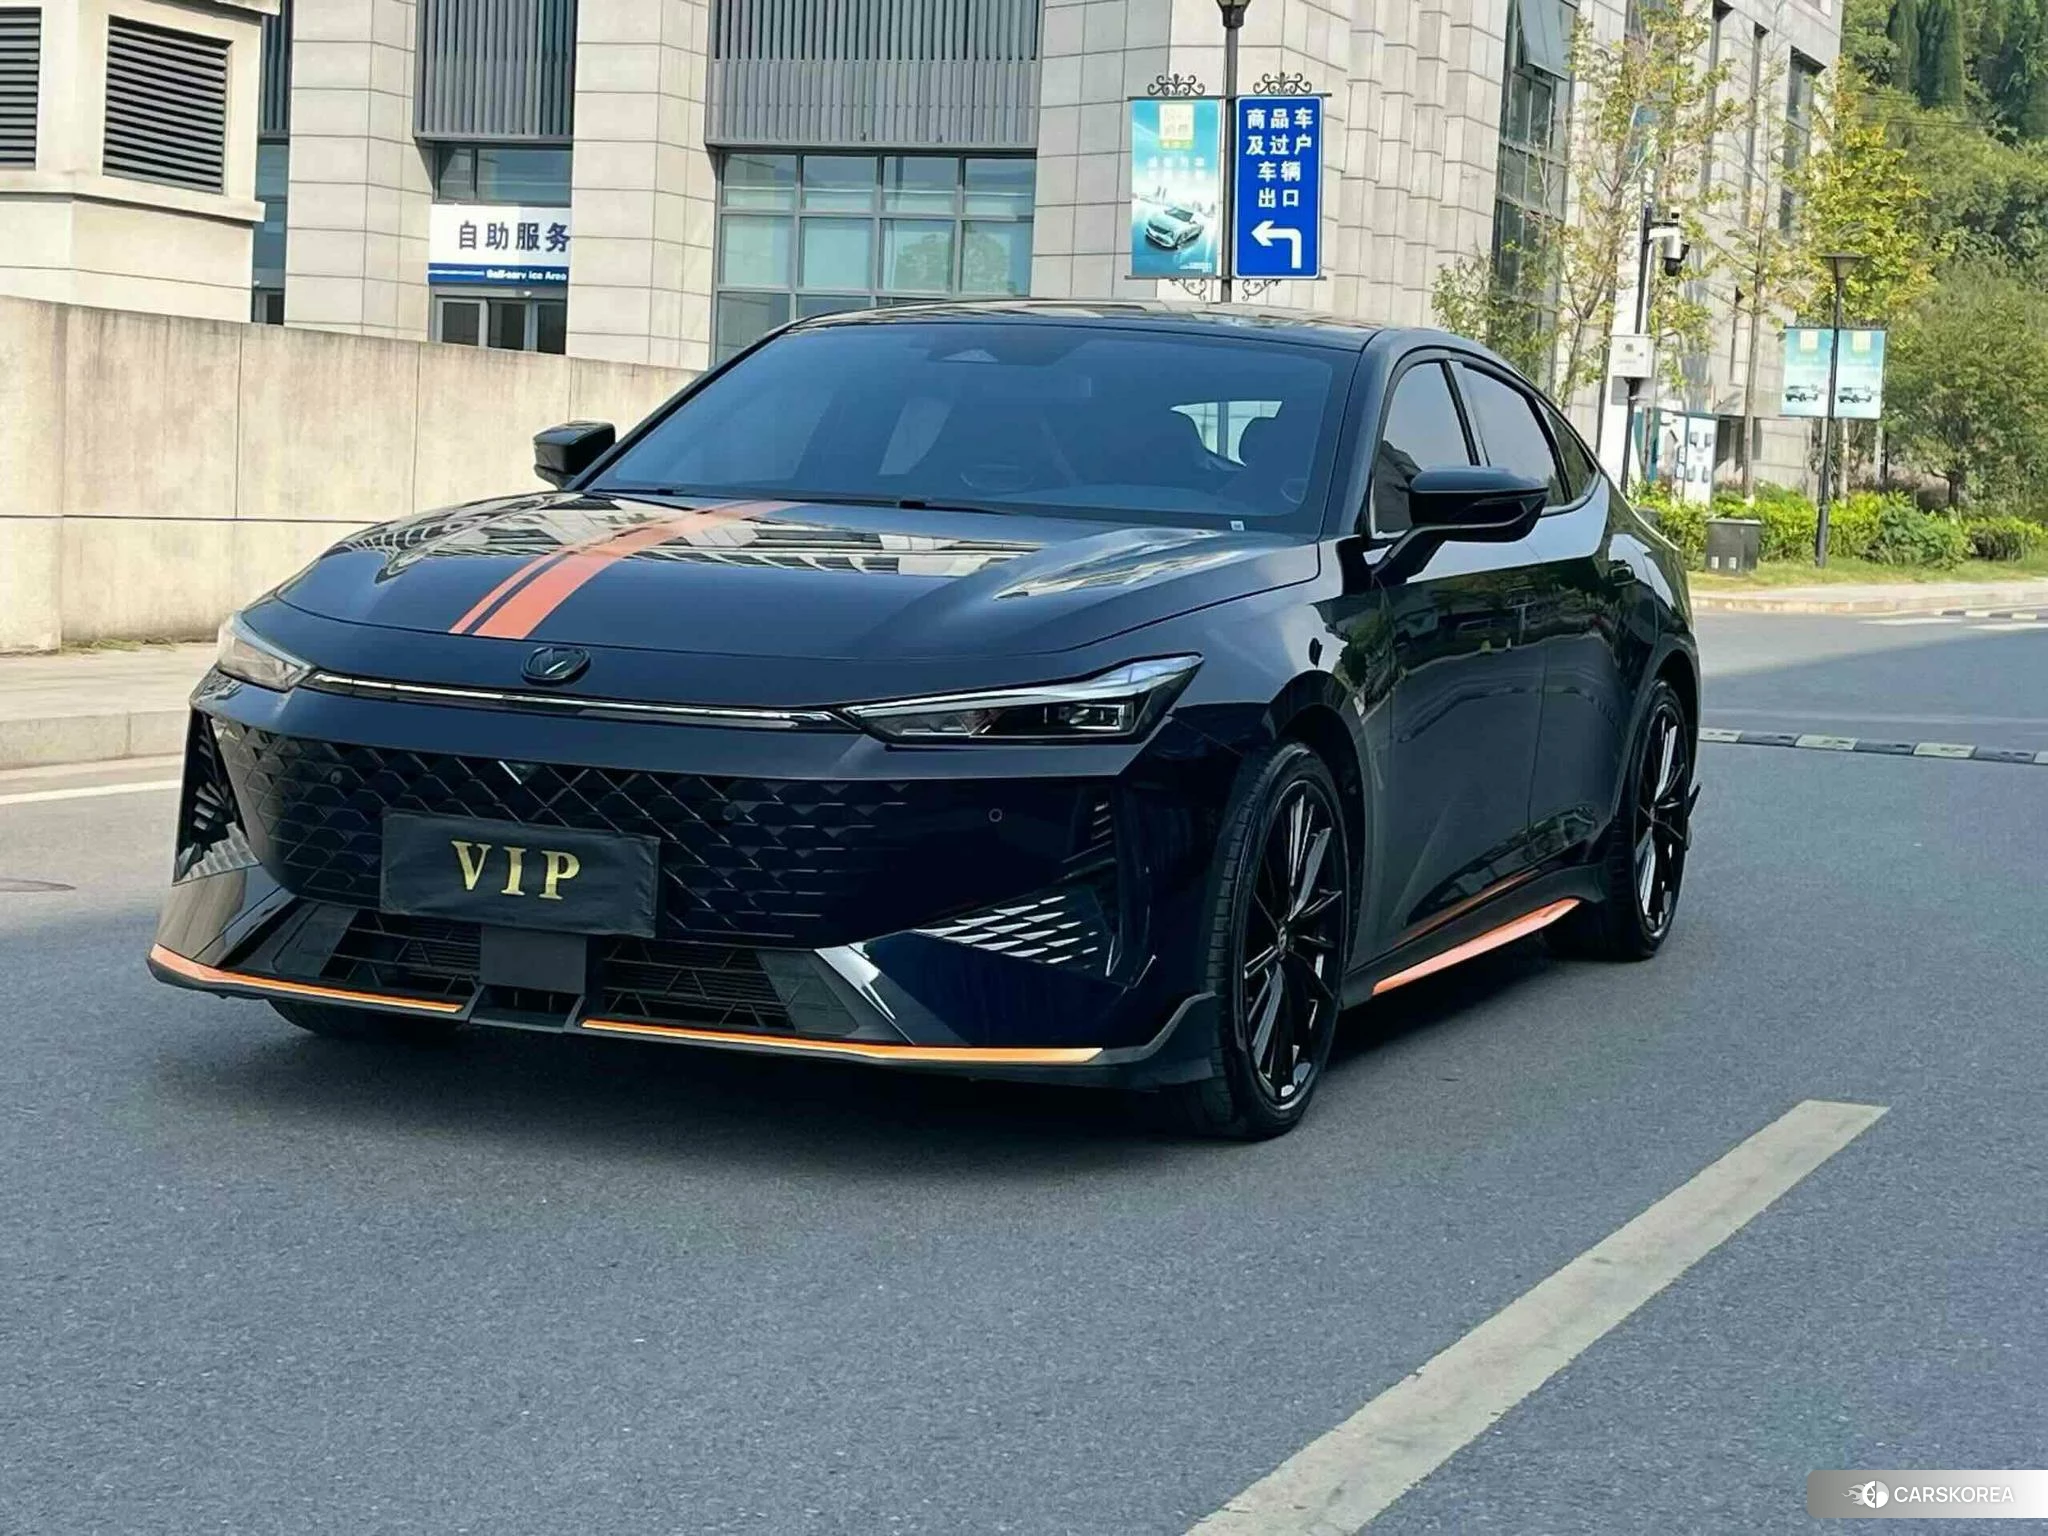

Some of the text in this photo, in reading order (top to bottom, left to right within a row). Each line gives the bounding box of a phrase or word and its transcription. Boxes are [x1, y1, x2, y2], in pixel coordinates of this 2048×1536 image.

[1246, 107, 1313, 130] 商品车
[1246, 134, 1312, 156] 及过户
[1258, 161, 1301, 182] 车辆
[1258, 188, 1300, 209] 出口
[459, 220, 570, 252] 自助服务
[451, 840, 581, 900] VIP
